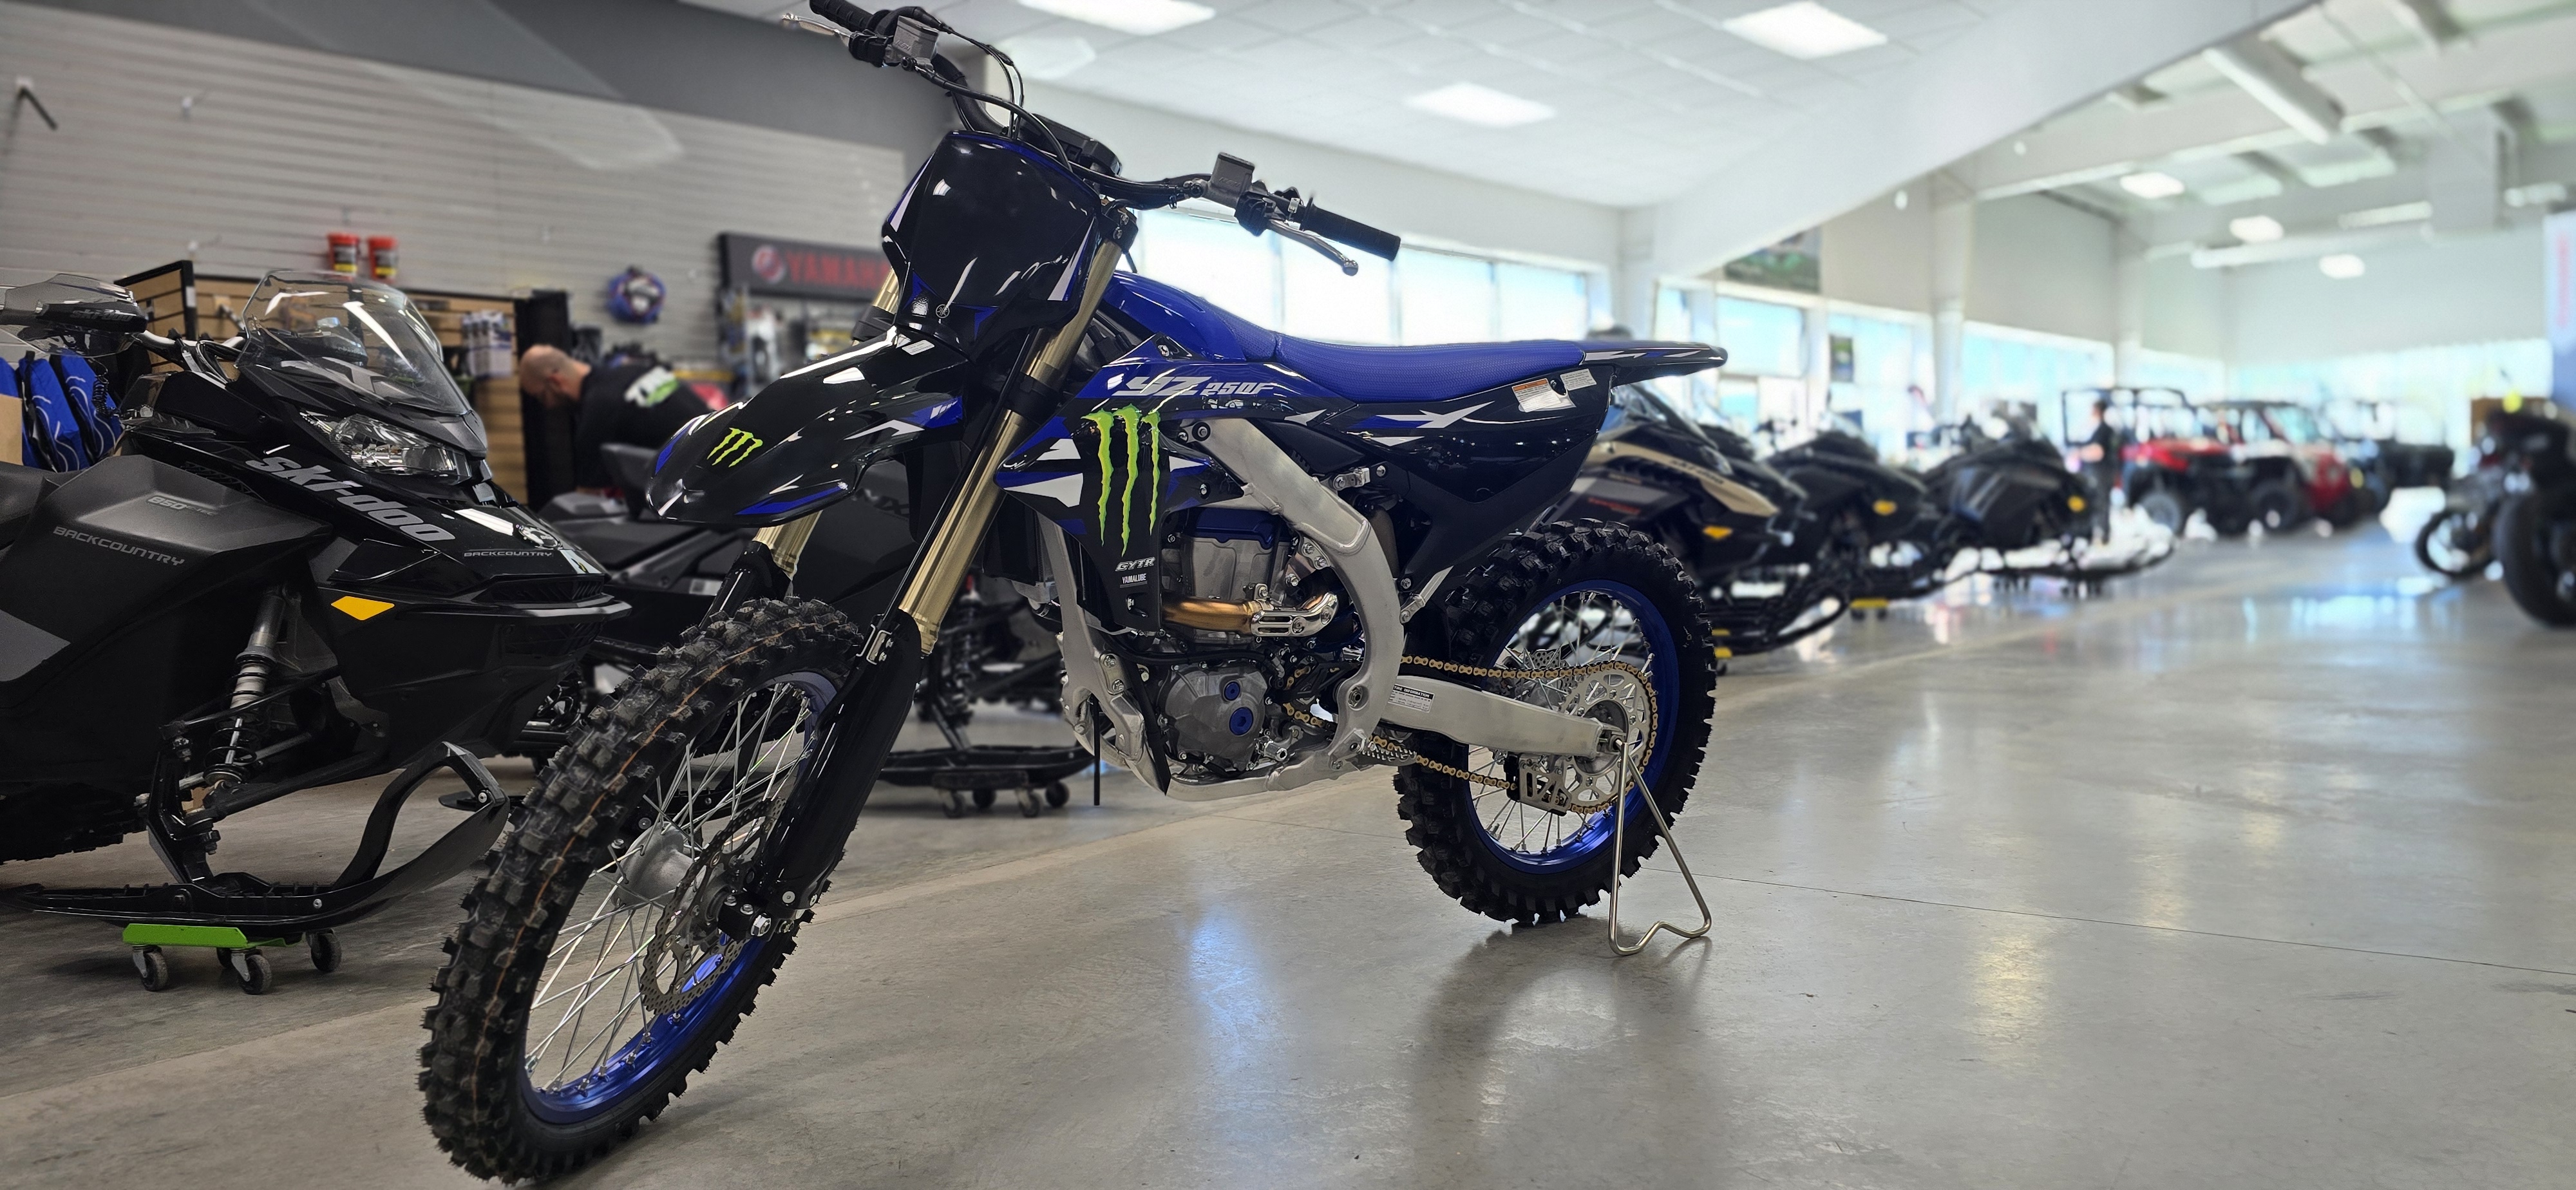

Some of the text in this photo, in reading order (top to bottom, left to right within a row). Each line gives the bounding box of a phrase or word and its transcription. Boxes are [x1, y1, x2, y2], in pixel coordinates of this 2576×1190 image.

[1112, 376, 1274, 395] YZ 250F
[148, 496, 187, 510] 850
[53, 526, 185, 566] BACKCOUNTRY
[1115, 556, 1155, 571] GYTR
[1122, 573, 1147, 583] YAMALUBE
[1403, 688, 1430, 697] INFORMATION
